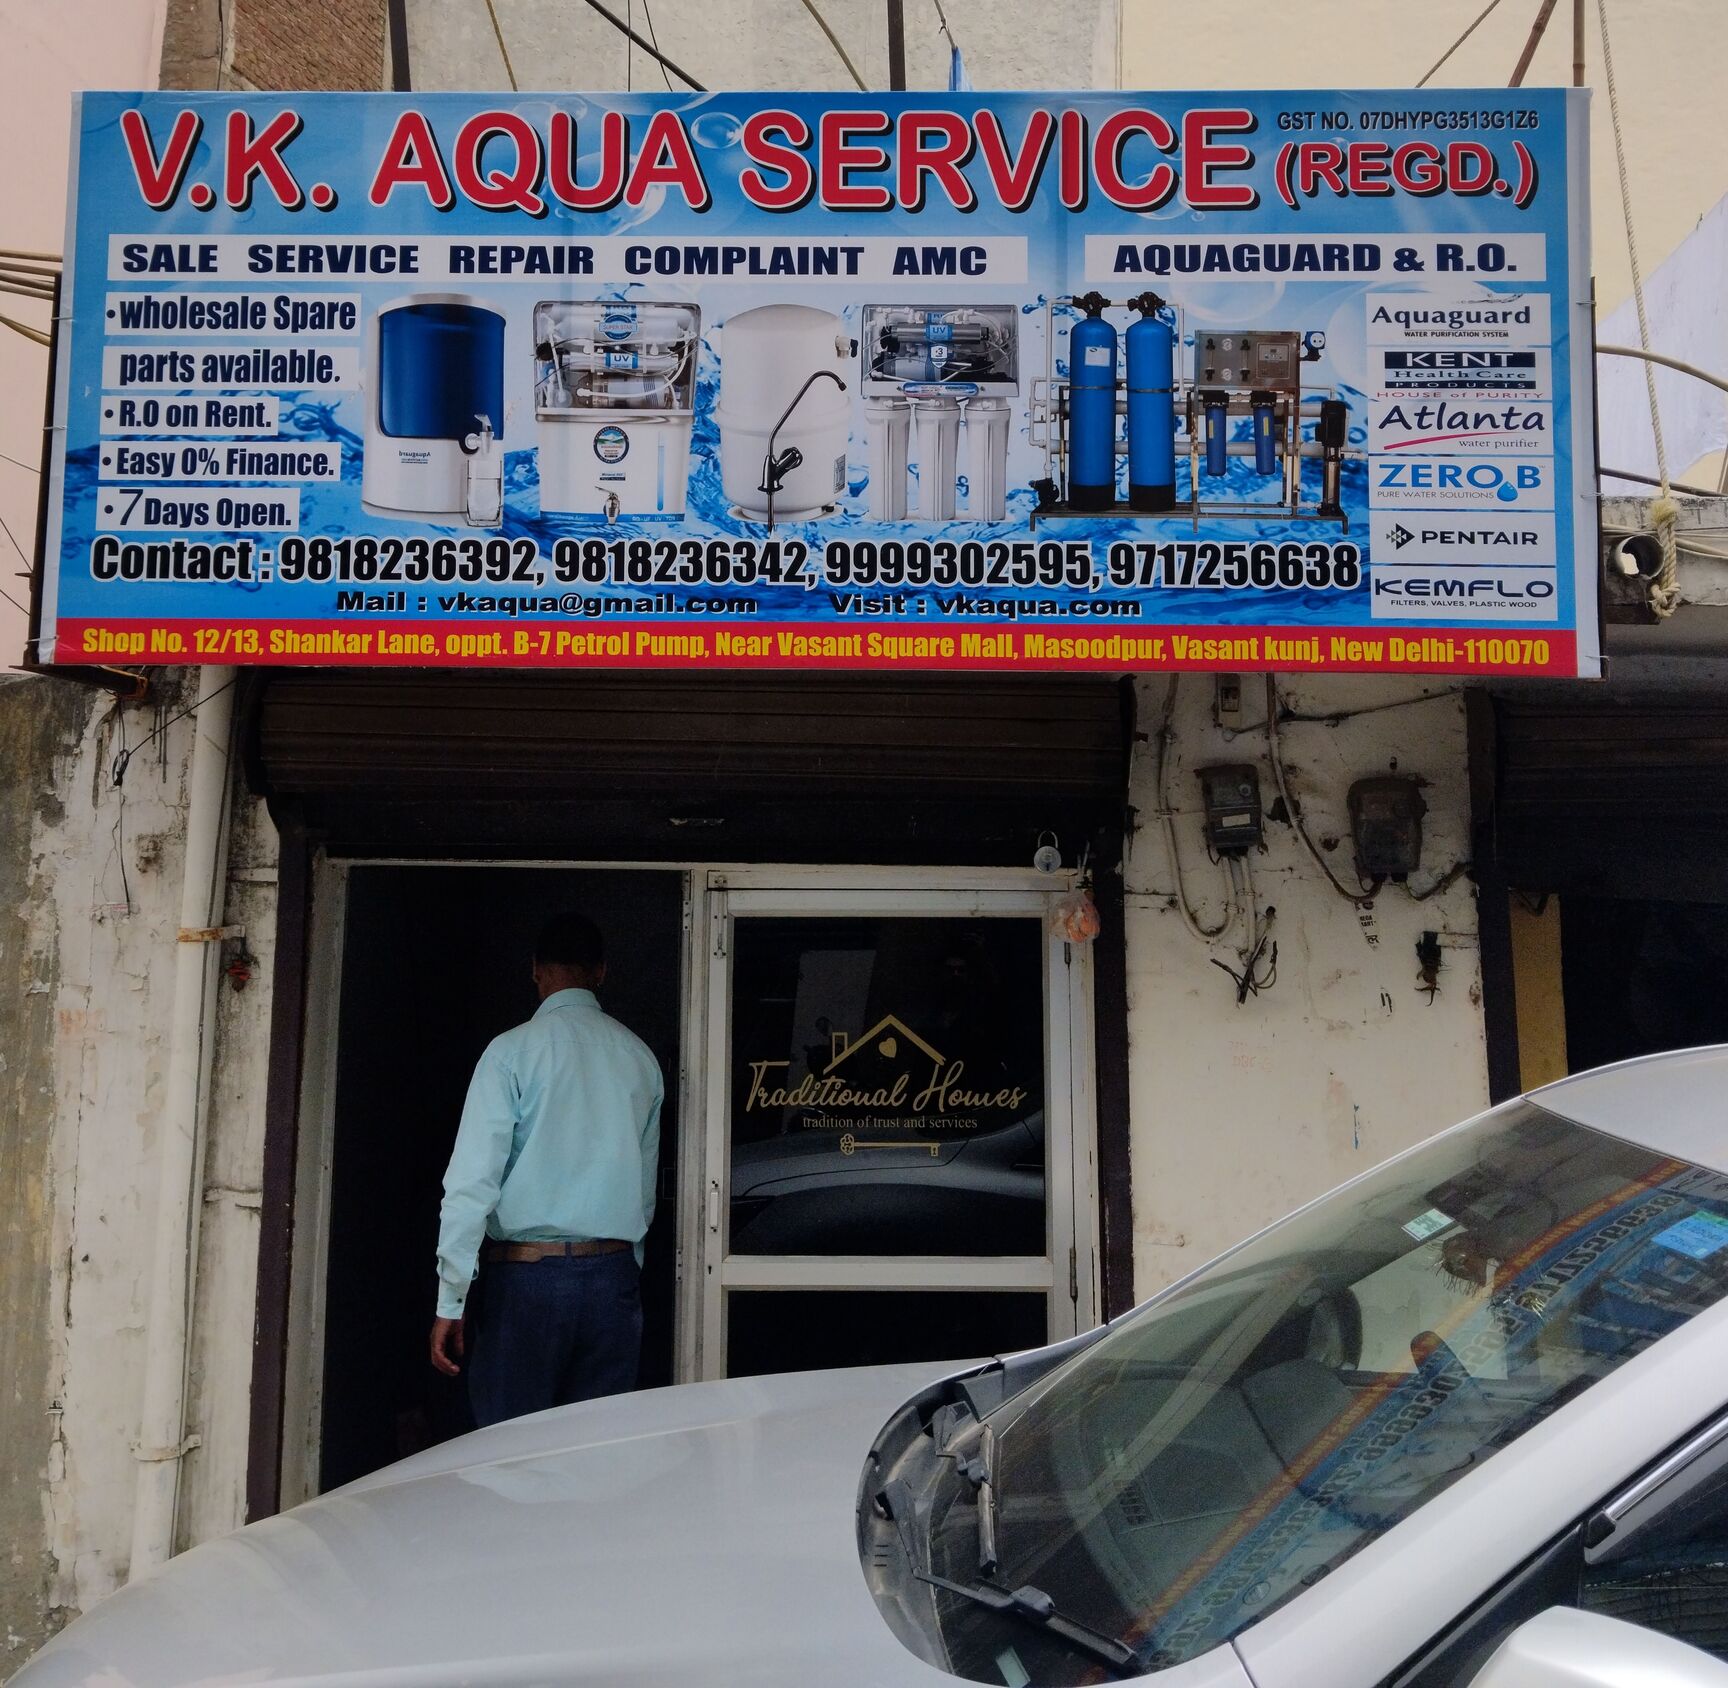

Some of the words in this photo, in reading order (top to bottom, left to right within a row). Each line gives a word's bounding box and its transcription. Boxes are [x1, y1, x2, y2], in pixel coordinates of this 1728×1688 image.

[1277, 111, 1313, 131] GST
[1320, 112, 1355, 131] NO.
[1360, 111, 1539, 130] 07DHYPG3513G1Z6
[120, 108, 337, 212] V.K.
[368, 110, 712, 217] AQUA
[739, 108, 1258, 213] SERVICE
[1273, 140, 1538, 209] (REGD.)
[122, 244, 218, 273] SALE
[247, 244, 420, 273] SERVICE
[449, 244, 595, 273] REPAIR
[624, 244, 864, 273] COMPLAINT
[892, 245, 987, 274] AMC
[1113, 244, 1380, 272] AQUAGUARD
[1393, 248, 1424, 271] &
[1436, 246, 1517, 272] R.O.
[120, 295, 266, 330] wholesale
[273, 295, 356, 333] Spare
[1372, 306, 1531, 329] Aquaguard
[932, 326, 946, 334] UV
[120, 349, 195, 385] parts
[202, 349, 341, 383] available.
[1406, 353, 1514, 367] KENT
[119, 400, 159, 427] R.O
[166, 405, 199, 428] on
[205, 401, 272, 428] Rent.
[1379, 402, 1545, 431] Atlanta
[1459, 440, 1490, 448] water
[1494, 438, 1539, 450] purifier
[116, 448, 176, 478] Easy
[181, 447, 219, 476] 0%
[226, 448, 334, 476] Finance.
[1379, 464, 1503, 488] ZERO
[1440, 491, 1494, 499] SOLUTIONS
[216, 498, 291, 529] Open.
[1422, 531, 1538, 545] PENTAIR
[280, 538, 545, 587] 9818236392,
[555, 540, 816, 589] 9818236342,
[826, 542, 1100, 592] 9999302595,
[1110, 543, 1359, 590] 9717256638
[1375, 578, 1554, 598] KEMFLO
[337, 592, 405, 613] Mail
[438, 592, 757, 618] vkaqua@gmail.com
[831, 594, 906, 615] Visit
[939, 597, 1141, 620] vkaqua.com
[83, 628, 145, 656] Shop
[151, 629, 187, 653] No.
[194, 629, 263, 657] 12/13,
[269, 629, 374, 655] Shankar
[377, 629, 440, 658] Lane,
[446, 632, 508, 658] oppt.
[514, 631, 550, 655] B-7
[556, 631, 630, 656] Petrol
[636, 632, 710, 659] Pump,
[715, 632, 772, 656] Near
[777, 632, 863, 657] Vasant
[868, 633, 956, 660] Square
[961, 633, 1018, 660] Mall,
[1023, 635, 1166, 663] Masoodpur,
[1171, 635, 1260, 661] Vasant
[1264, 637, 1325, 664] kunj,
[1330, 637, 1383, 661] New
[1389, 637, 1550, 665] Delhi-110070
[746, 1060, 911, 1112] Traditional
[913, 1060, 1027, 1113] Homes
[803, 1115, 854, 1129] tradition
[856, 1115, 870, 1128] of
[873, 1116, 900, 1128] trust
[903, 1115, 926, 1128] and
[929, 1117, 978, 1129] services
